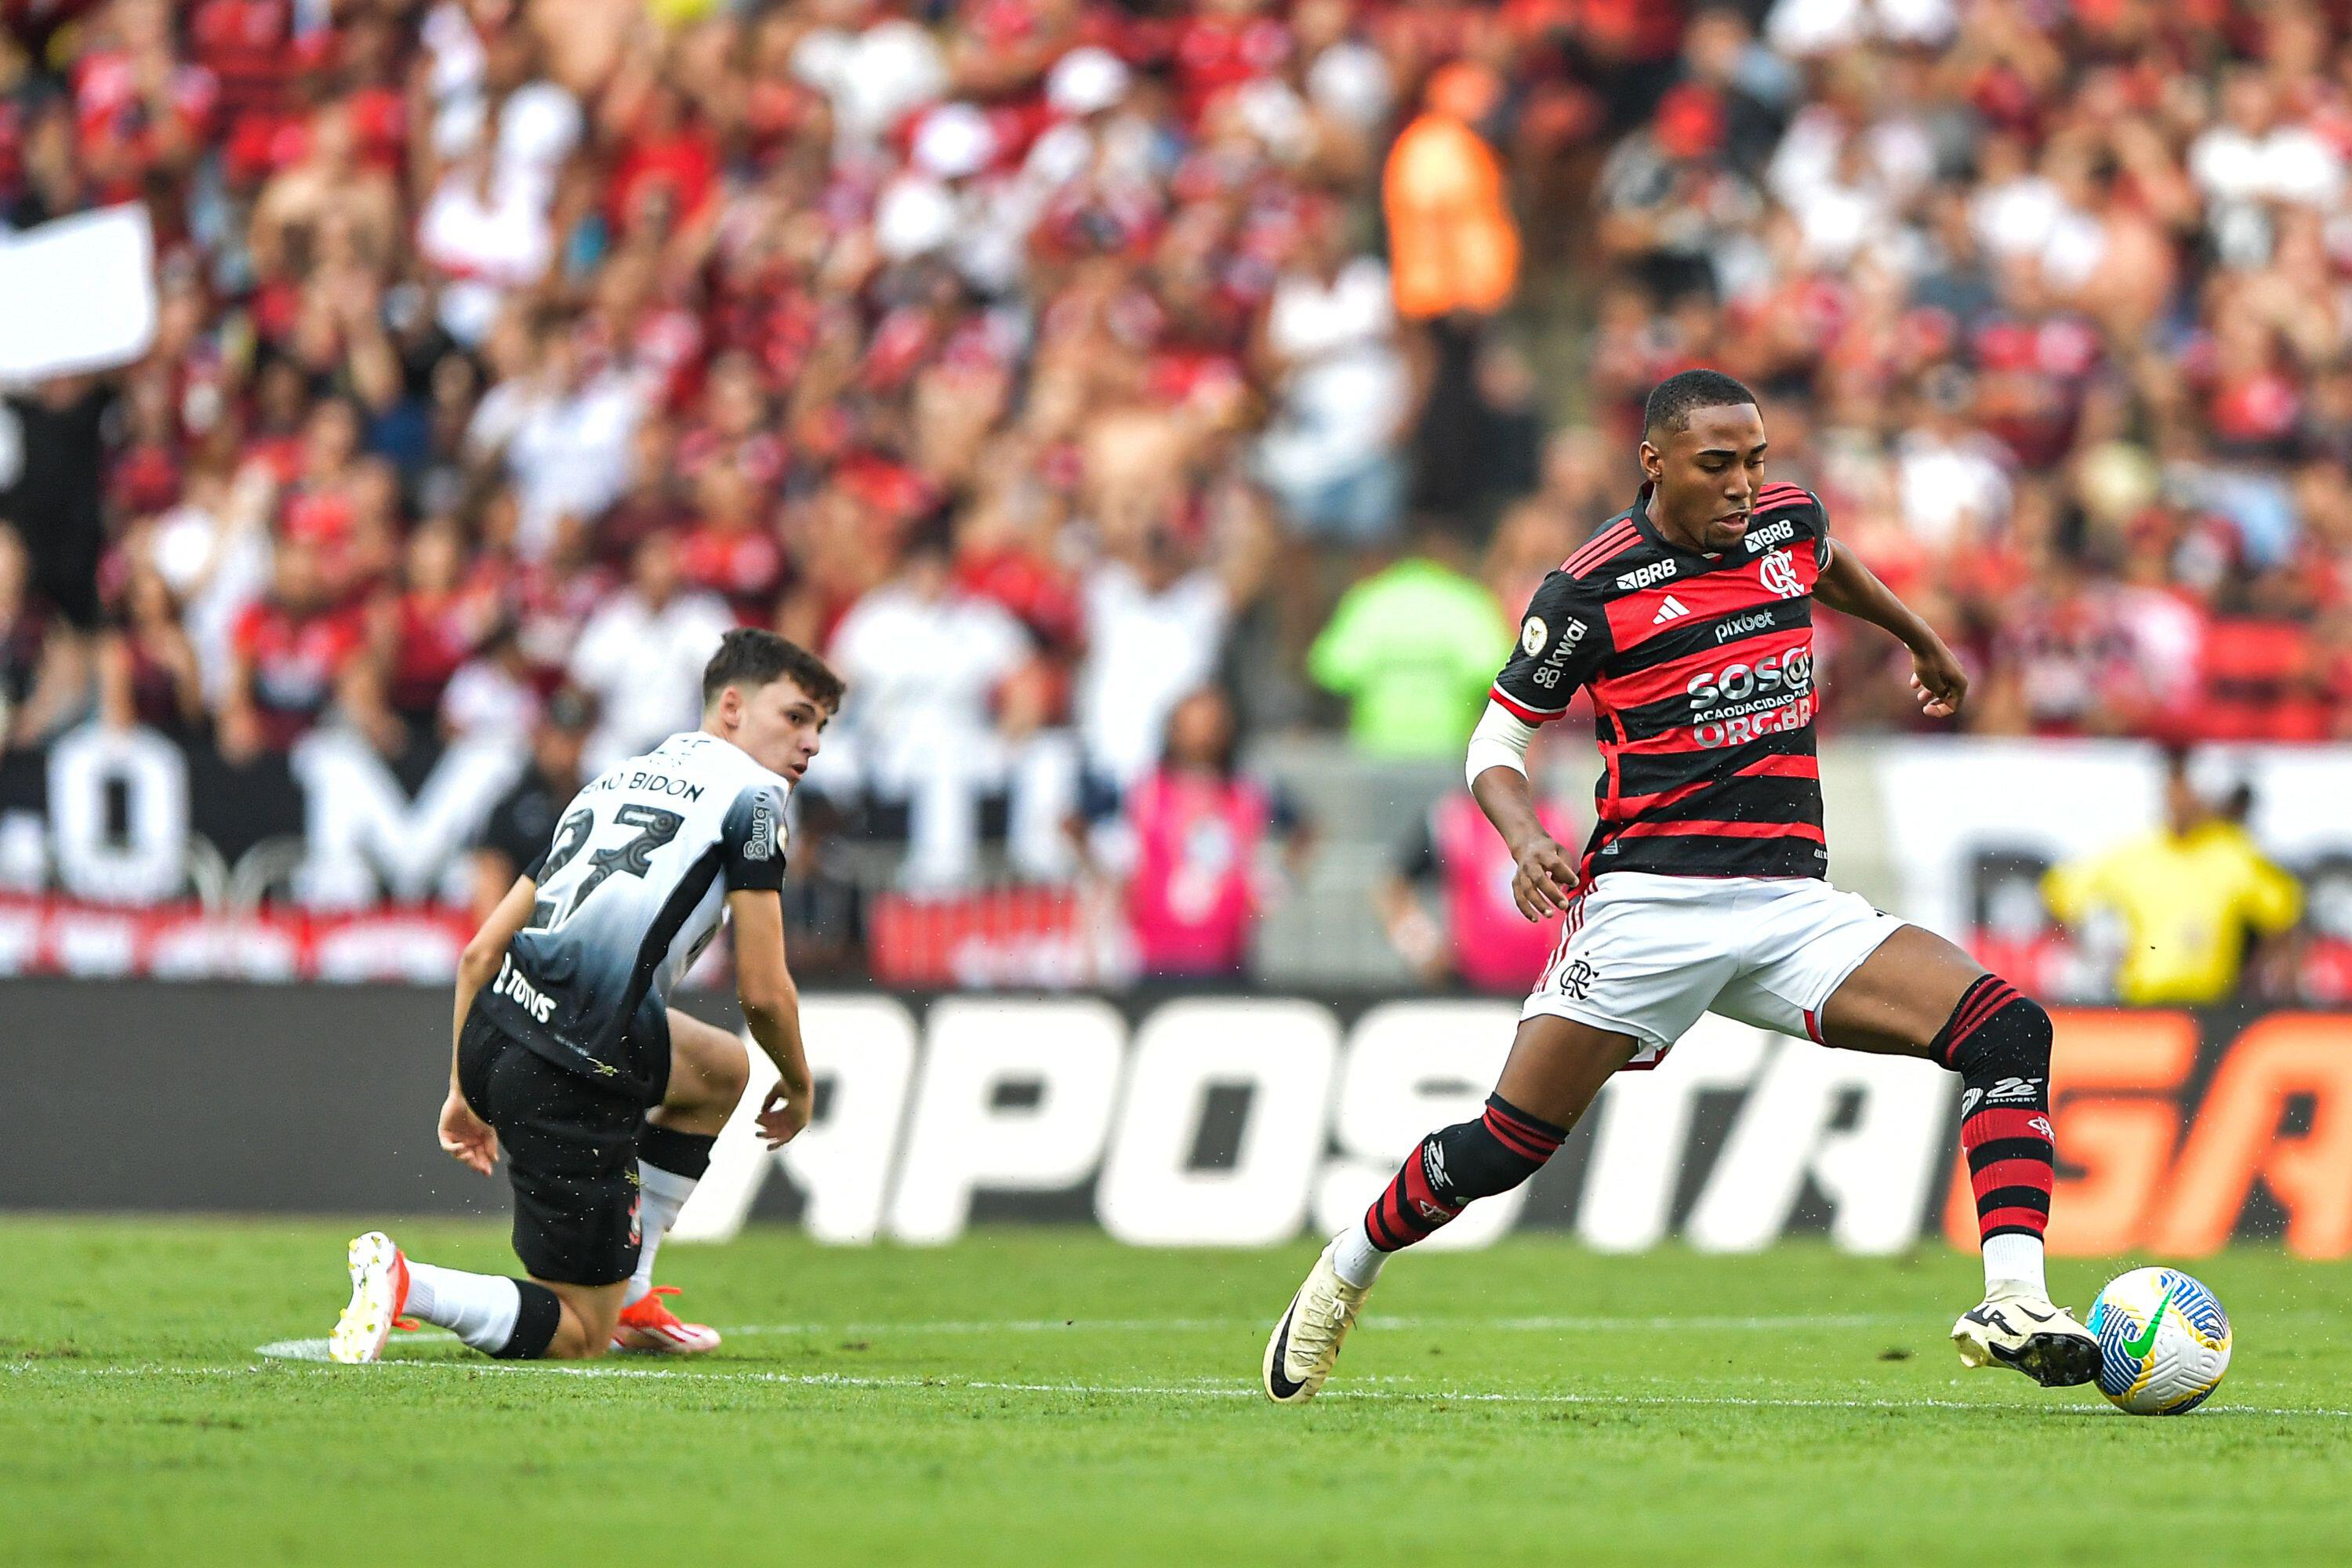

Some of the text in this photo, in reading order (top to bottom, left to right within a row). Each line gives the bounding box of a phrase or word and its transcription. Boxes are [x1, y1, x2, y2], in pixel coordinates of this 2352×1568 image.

[1759, 519, 1795, 547] BRB
[1635, 557, 1678, 589] BRB
[1543, 615, 1588, 667] kwai
[1715, 608, 1777, 644] pixbet
[1686, 646, 1810, 710] SOS@
[1693, 698, 1812, 749] ORG.BR
[628, 771, 705, 804] BIDON
[523, 803, 685, 931] 27
[504, 967, 557, 1024] TOTVS
[663, 993, 1958, 1253] APOSTA
[1985, 1096, 2037, 1105] DELIVERY
